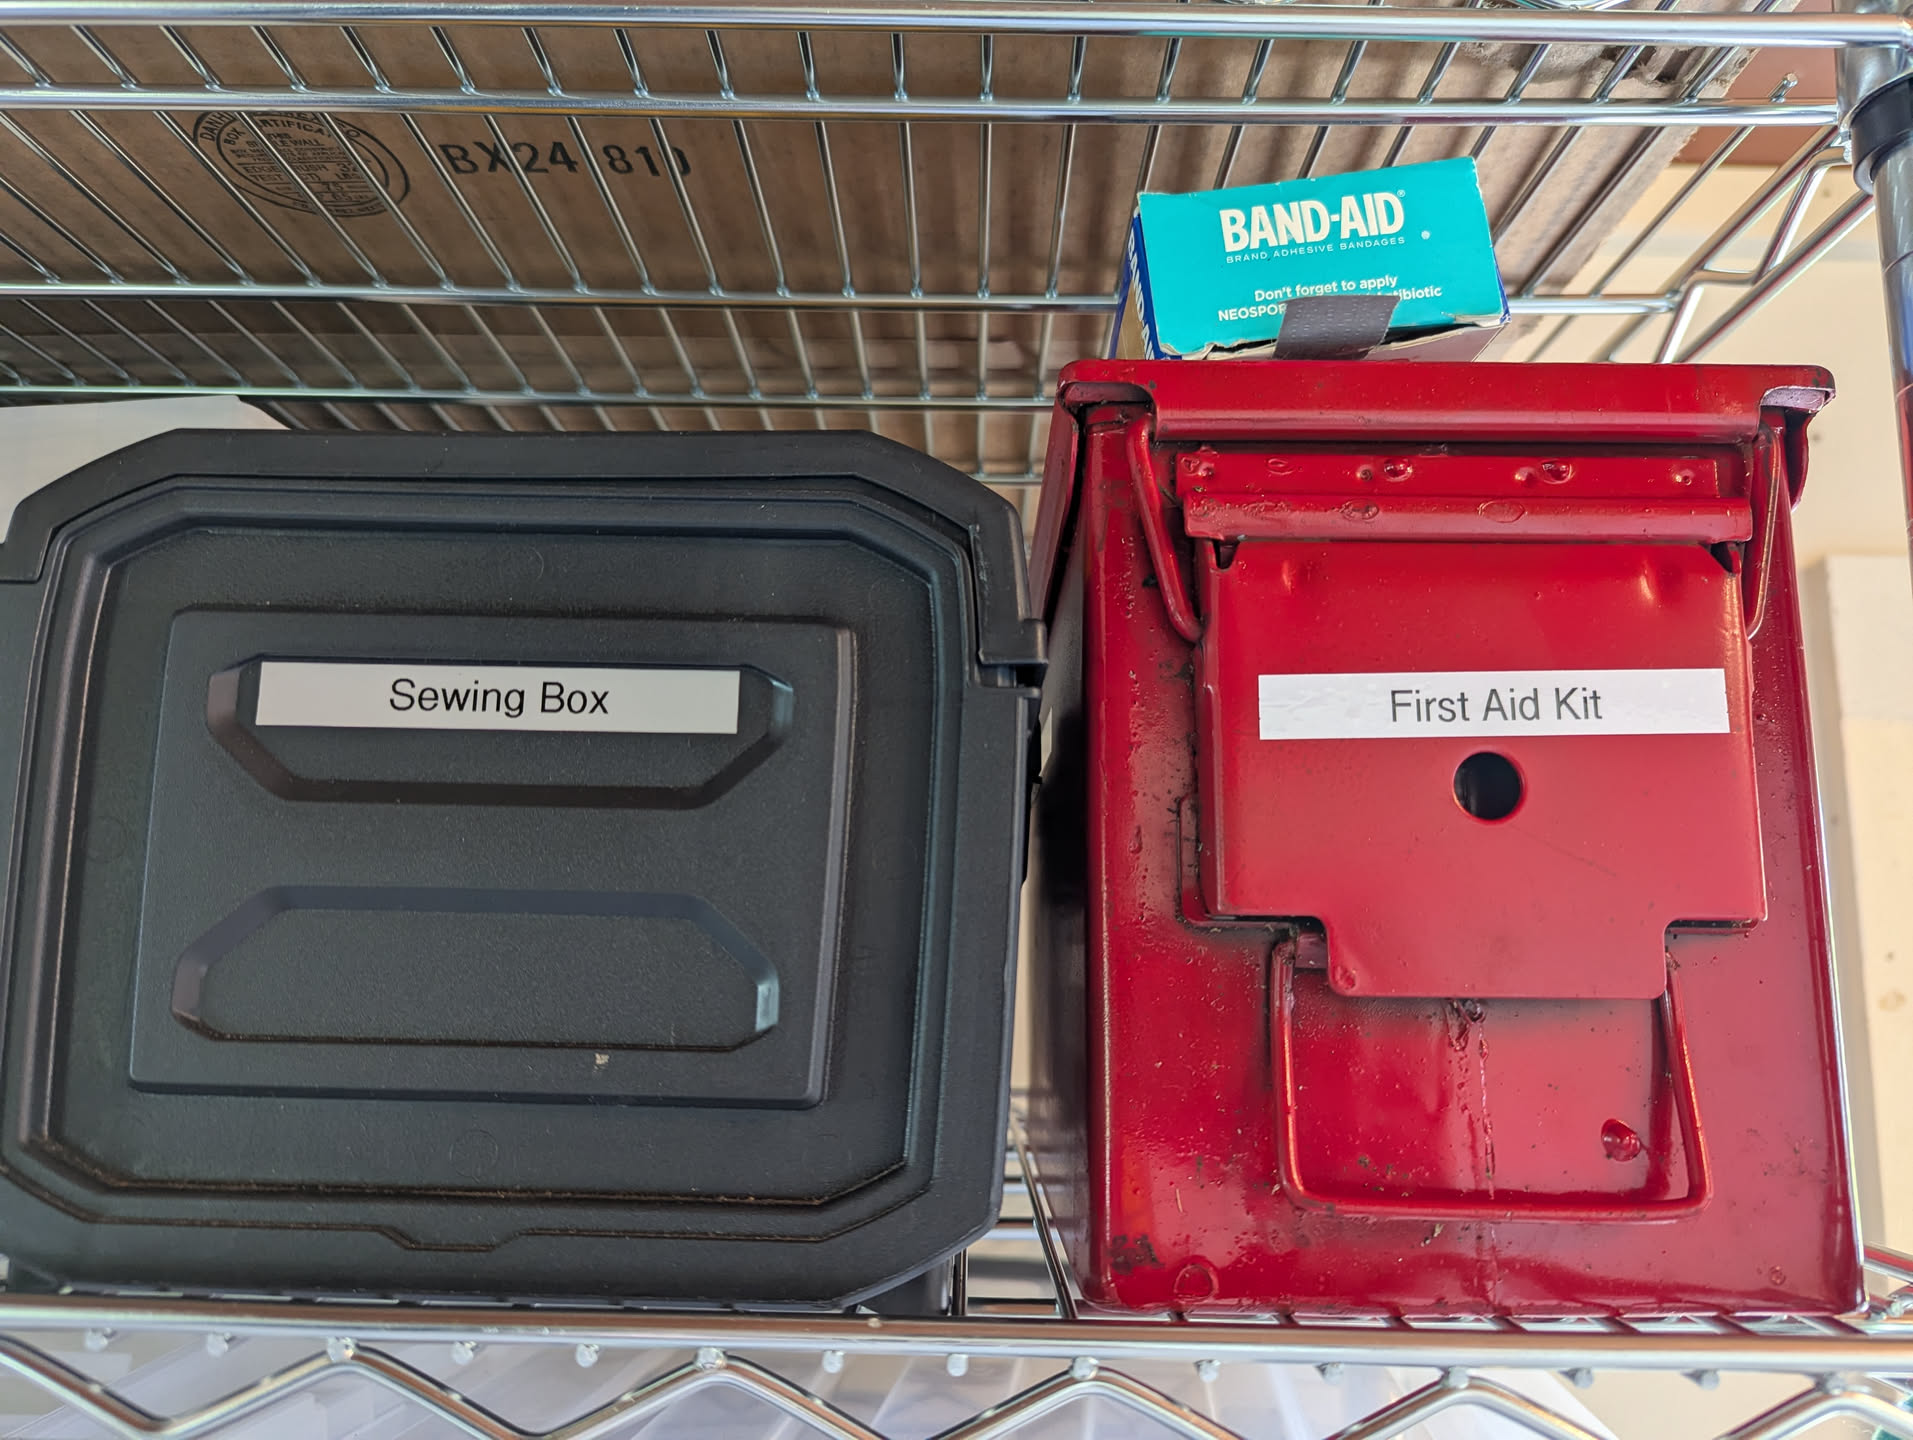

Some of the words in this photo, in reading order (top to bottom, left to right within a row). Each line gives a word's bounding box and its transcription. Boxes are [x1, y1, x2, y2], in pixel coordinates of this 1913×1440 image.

[1226, 252, 1268, 264] BRAND
[1273, 243, 1334, 258] ADHESIVE
[1340, 236, 1406, 250] BANDAGES
[1254, 285, 1293, 302] Don't
[1295, 282, 1338, 298] forget
[1341, 278, 1356, 291] to
[1359, 273, 1398, 293] apply
[390, 678, 526, 719] Sewing
[540, 681, 610, 715] Box
[1391, 687, 1469, 722] First
[1482, 686, 1541, 721] Aid
[1555, 685, 1603, 720] Kit
